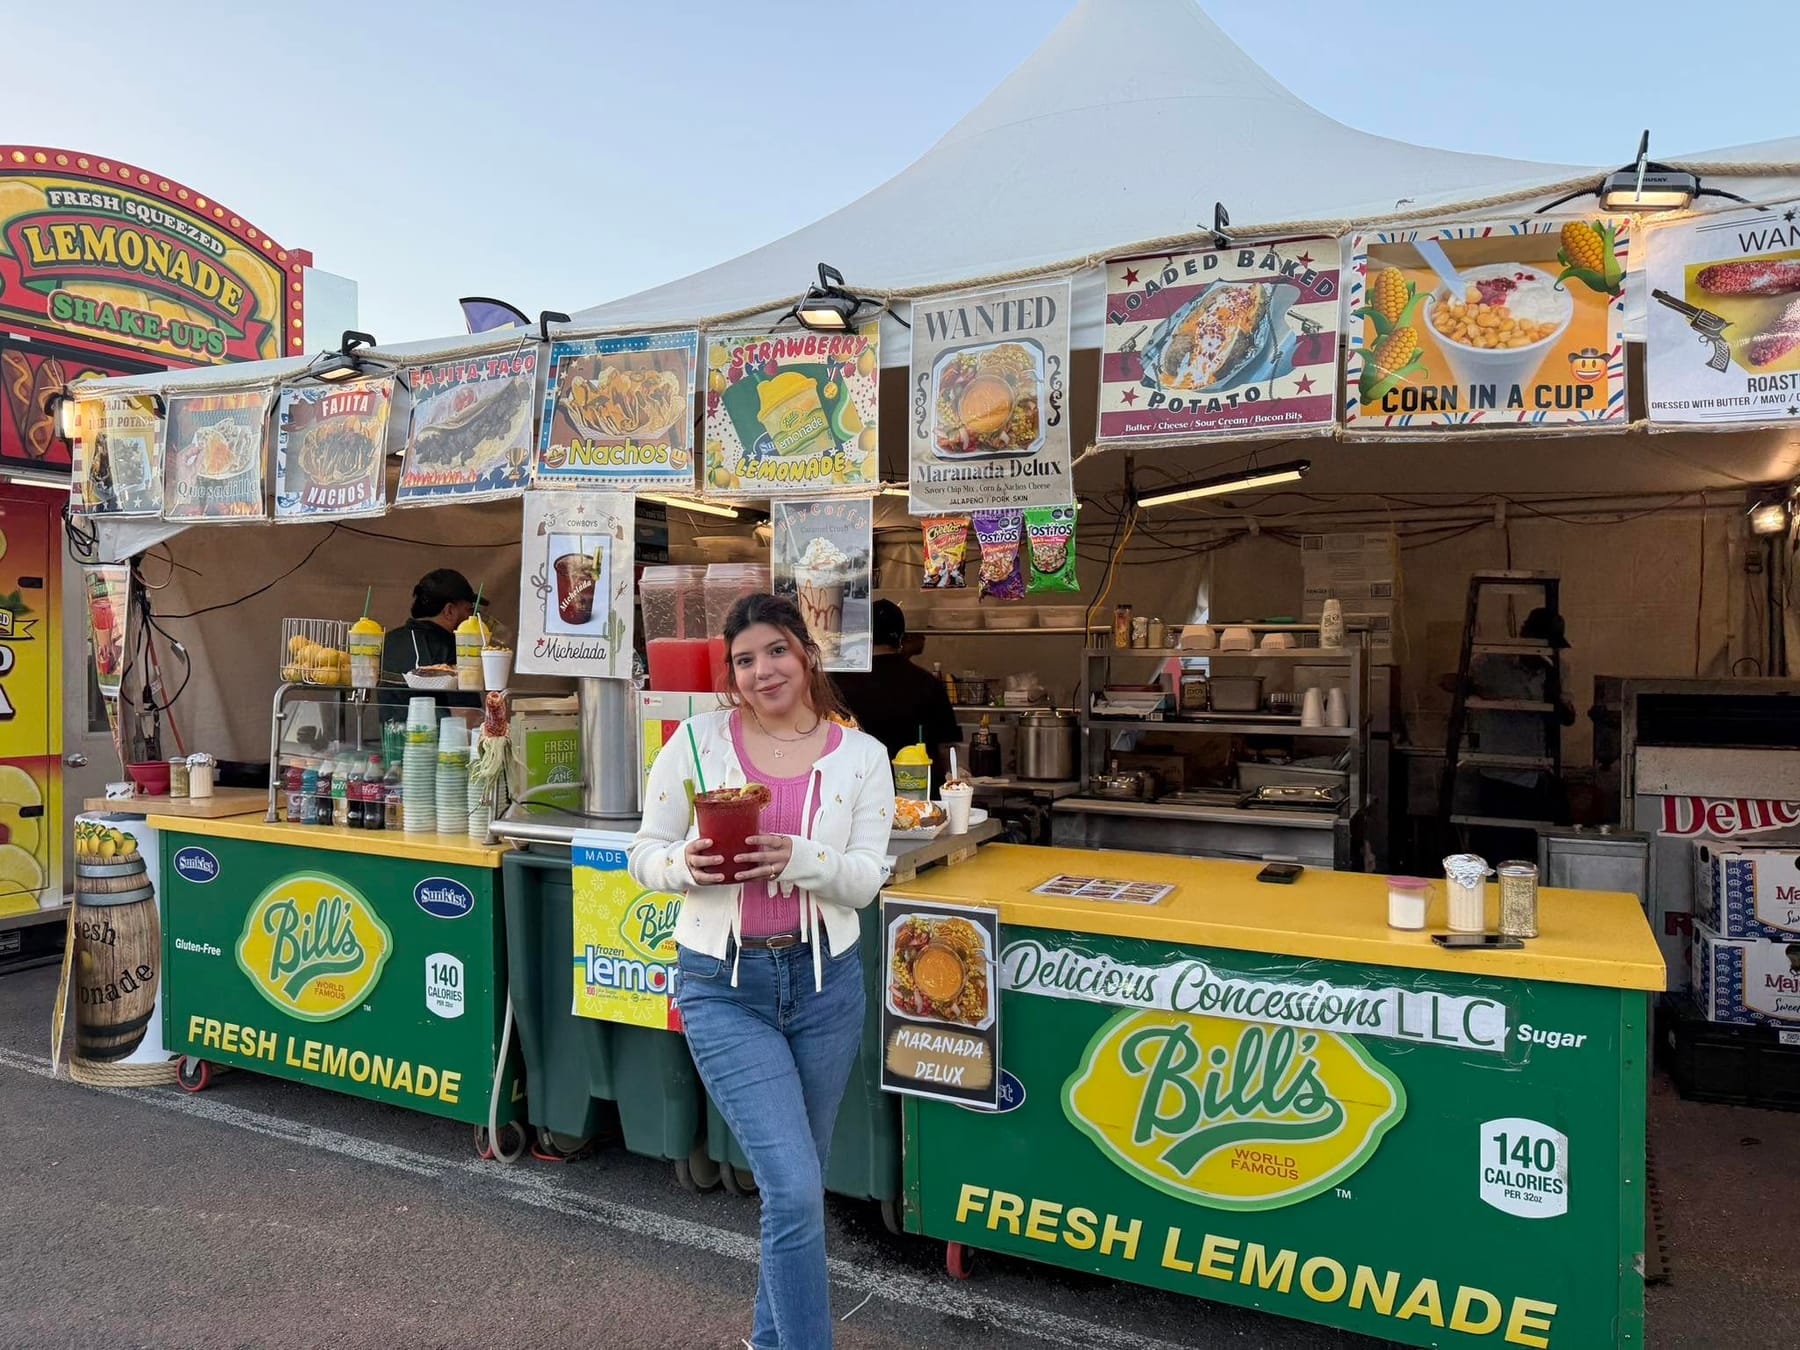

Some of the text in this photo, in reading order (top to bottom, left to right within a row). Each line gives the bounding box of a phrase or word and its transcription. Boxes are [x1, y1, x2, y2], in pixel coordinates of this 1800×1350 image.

[48, 190, 224, 256] FRESH SQUEEZED
[23, 224, 244, 315] LEMONADE
[1108, 250, 1335, 326] LOADED BAKED
[52, 292, 224, 355] SHAKE-UPS
[924, 296, 1057, 342] WANTED
[731, 335, 868, 368] STRAWBERRY
[409, 353, 535, 388] FAJITA TACO
[1747, 373, 1800, 393] ROAST
[321, 396, 370, 416] FAJITA
[1147, 386, 1262, 414] POTATO
[1381, 384, 1595, 413] CORN IN A CUP
[1651, 400, 1690, 409] DRESSED
[1692, 399, 1714, 408] WITH
[1716, 396, 1750, 407] BUTTER
[1760, 393, 1786, 404] MAYO
[1125, 423, 1151, 432] Butter
[1158, 421, 1189, 430] Cheese
[1195, 418, 1216, 428] Sour
[1217, 417, 1248, 426] Cream
[1255, 413, 1284, 423] Bacon
[1285, 412, 1303, 420] Bits
[568, 438, 668, 466] Nachos
[734, 452, 847, 481] LEMONADE
[916, 458, 1062, 483] Maranada Delux
[307, 483, 365, 505] NACHOS
[1028, 482, 1051, 490] Cheese
[567, 519, 599, 527] COWBOYS
[559, 579, 592, 611] Michelada
[533, 637, 608, 661] Michelada
[544, 739, 577, 753] FRESH
[544, 752, 574, 764] FRUIT
[178, 855, 214, 875] Sunkist
[585, 850, 622, 863] MADE
[420, 887, 467, 909] Sunkist
[175, 938, 221, 956] Gluten-Free
[263, 896, 365, 990] Bill's
[595, 944, 625, 957] frozen
[315, 980, 345, 992] WORLD
[431, 962, 459, 988] 140
[314, 987, 346, 1001] FAMOUS
[428, 986, 463, 1002] CALORIES
[1000, 941, 1497, 1047] Delicious Concessions LLC
[363, 1004, 371, 1012] TM
[895, 1029, 985, 1059] MARANADA
[1516, 1024, 1588, 1048] Sugar
[187, 1015, 278, 1061] FRESH
[285, 1036, 462, 1104] LEMONADE
[914, 1061, 965, 1086] DELUX
[1120, 1023, 1343, 1155] Bill's
[1234, 1148, 1296, 1169] WORLD
[1493, 1132, 1557, 1173] 140
[1231, 1159, 1299, 1181] FAMOUS
[1484, 1166, 1564, 1195] CALORIES
[1335, 1188, 1352, 1199] TM
[1504, 1188, 1544, 1203] PER 32oz
[954, 1183, 1559, 1348] FRESH LEMONADE
